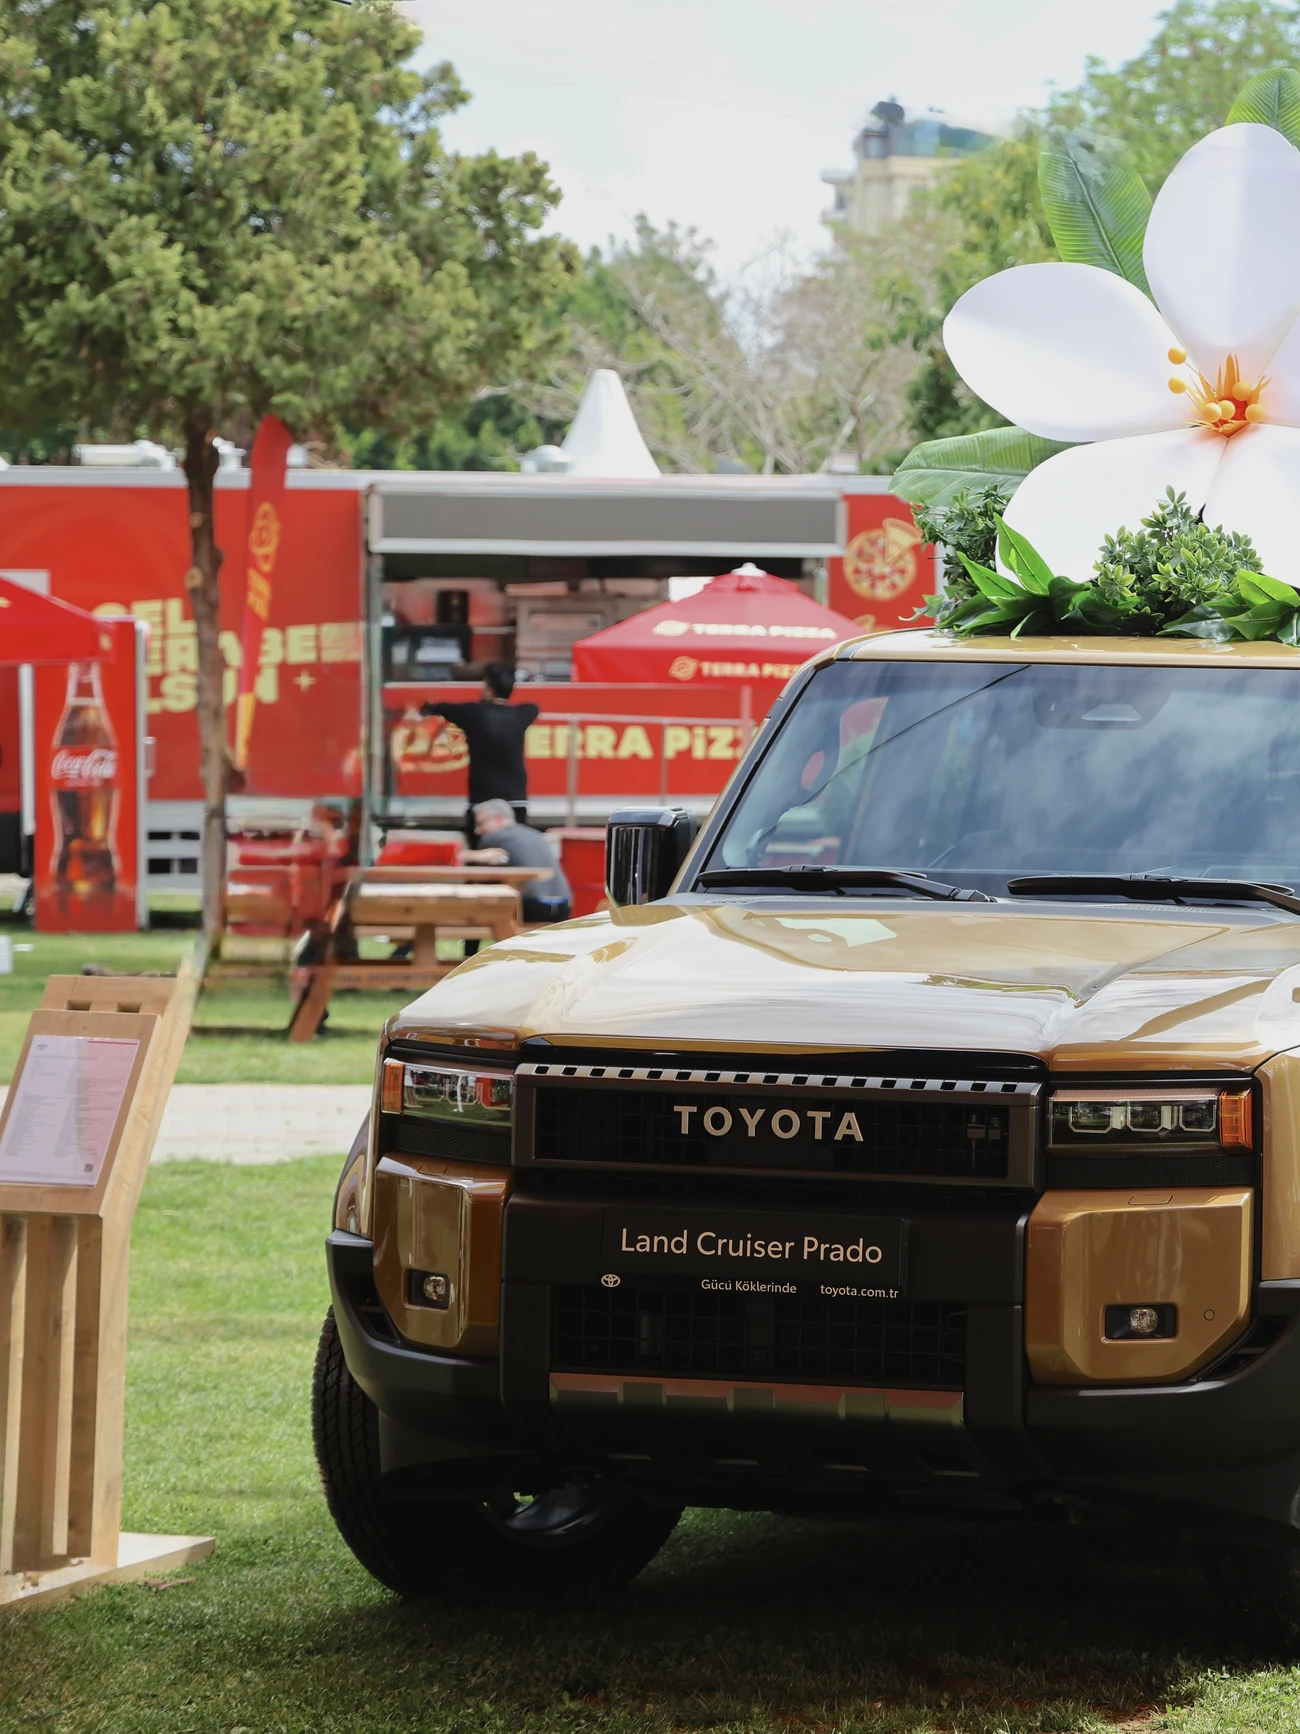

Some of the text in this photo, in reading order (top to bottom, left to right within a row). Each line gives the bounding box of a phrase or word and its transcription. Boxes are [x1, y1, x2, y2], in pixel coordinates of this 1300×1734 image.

[700, 660, 760, 678] TERRA
[524, 724, 654, 760] ERRA
[673, 1105, 864, 1142] TOYOTA
[620, 1227, 884, 1264] Land Cruiser Prado
[735, 1279, 798, 1294] Köklerinde
[819, 1283, 899, 1299] toyota.com.tr
